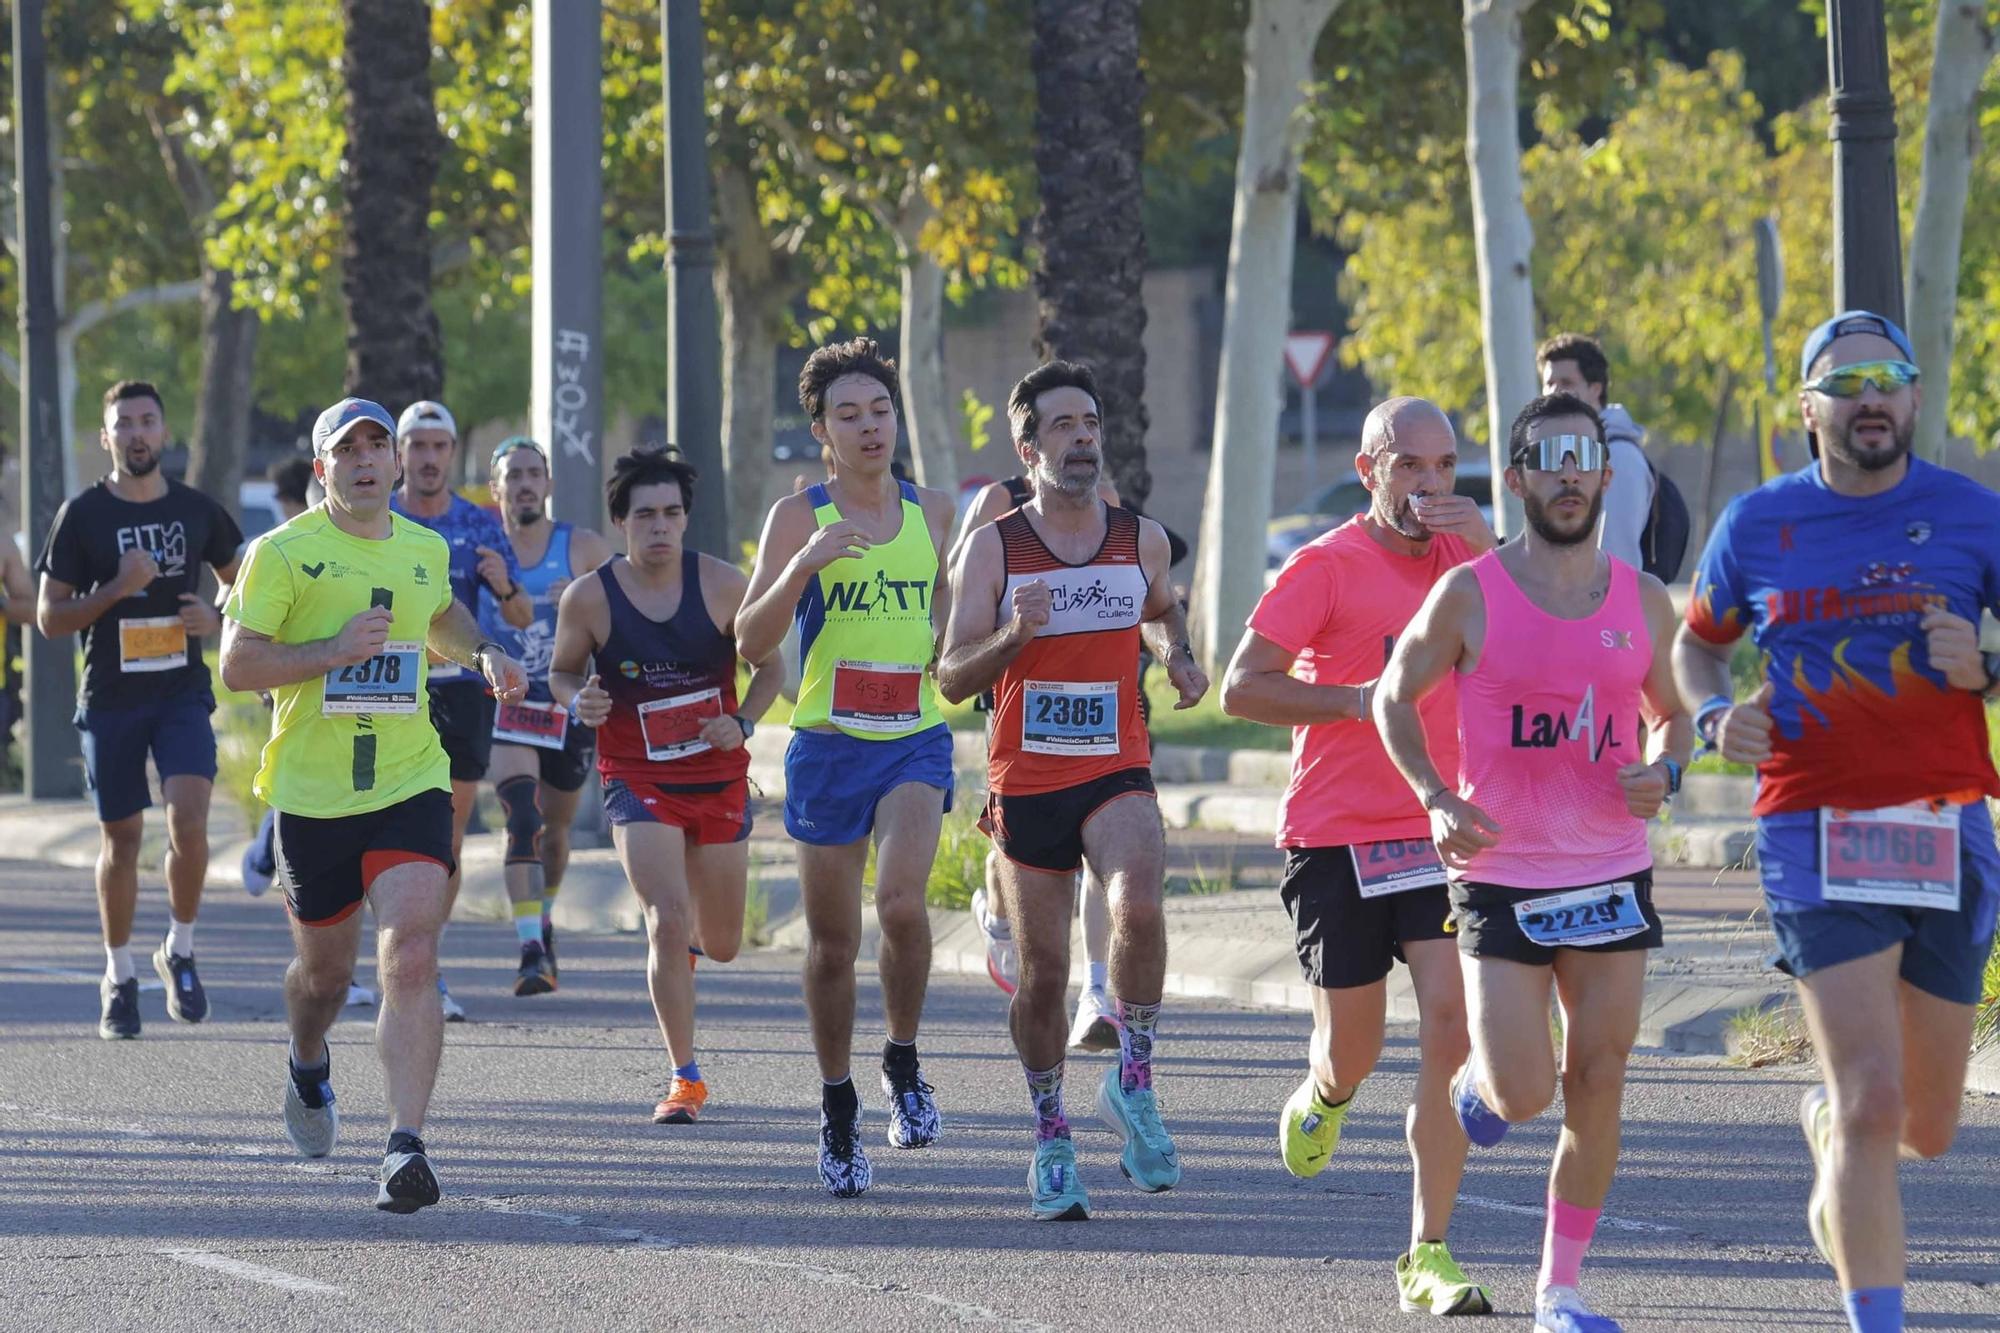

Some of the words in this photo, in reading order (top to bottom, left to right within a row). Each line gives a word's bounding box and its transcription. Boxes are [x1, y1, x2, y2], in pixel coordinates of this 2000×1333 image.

[117, 523, 160, 555] FIT
[1097, 610, 1134, 619] Cullera
[338, 655, 401, 684] 2378
[1035, 694, 1104, 727] 2385
[1839, 825, 1936, 867] 3066
[1541, 902, 1620, 933] 2229
